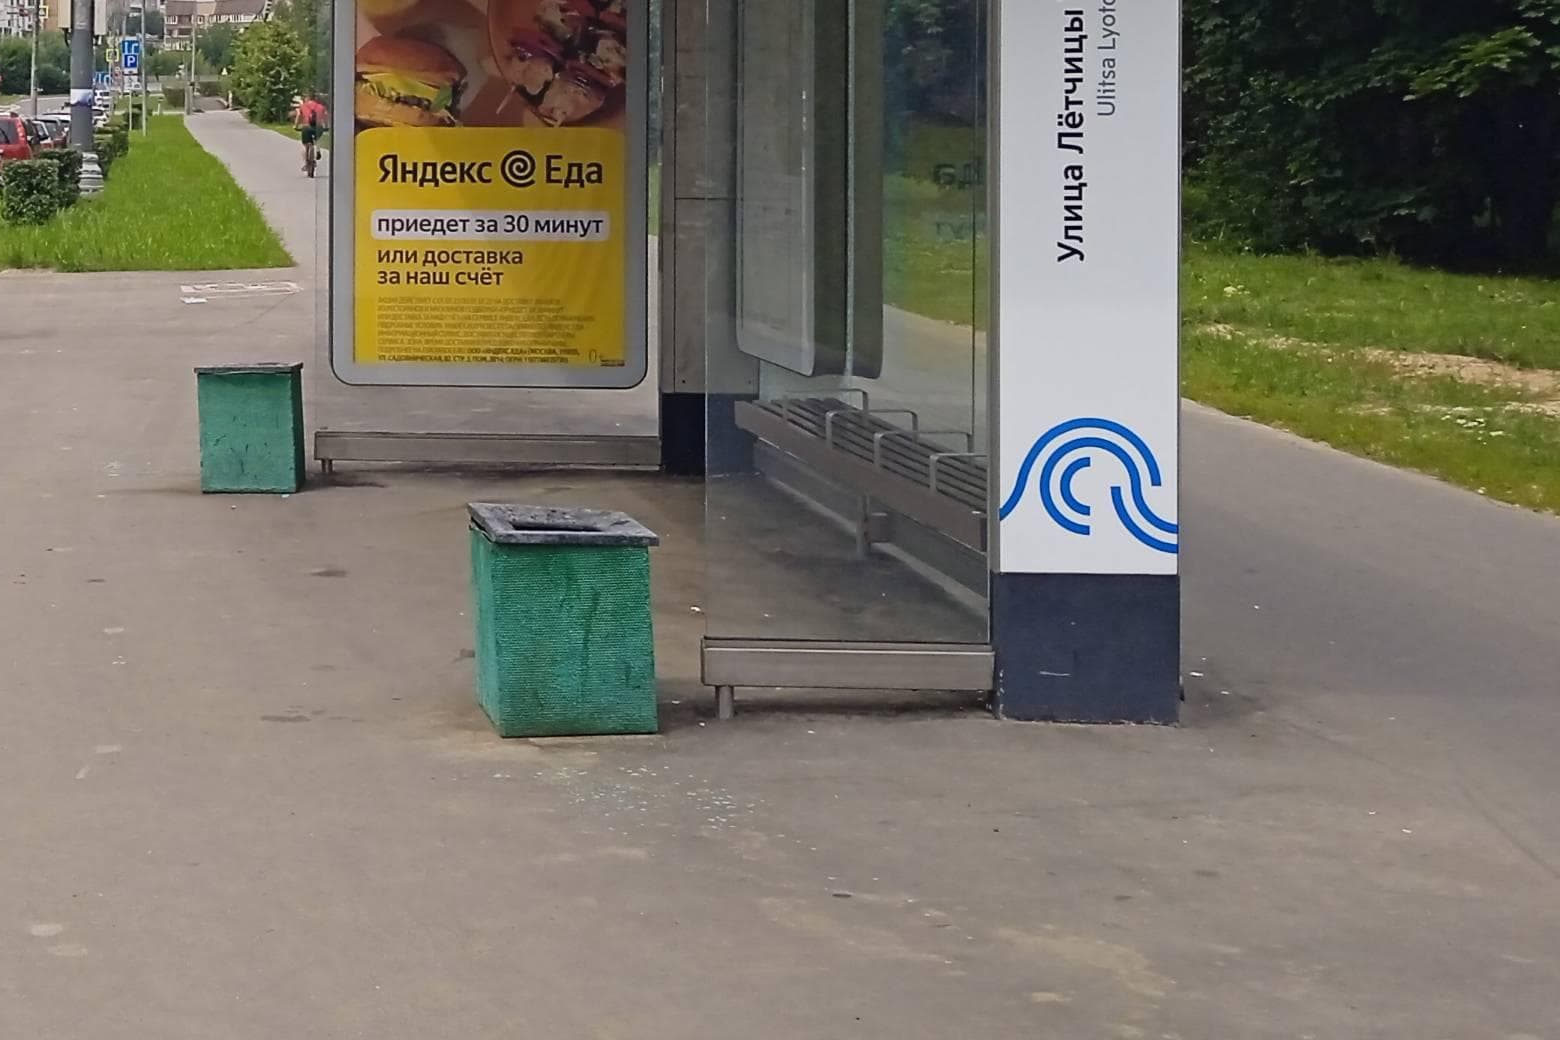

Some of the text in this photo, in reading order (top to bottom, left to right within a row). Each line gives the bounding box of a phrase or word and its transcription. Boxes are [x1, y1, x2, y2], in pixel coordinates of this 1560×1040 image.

[1057, 9, 1089, 155] Лётчицы
[1096, 57, 1116, 116] Ulitsa
[378, 154, 604, 189] Яндекс Еда
[377, 214, 604, 237] приедет за 30 минут
[1056, 164, 1087, 263] Улица
[377, 249, 524, 270] или доставка
[377, 266, 505, 287] за наш счёт
